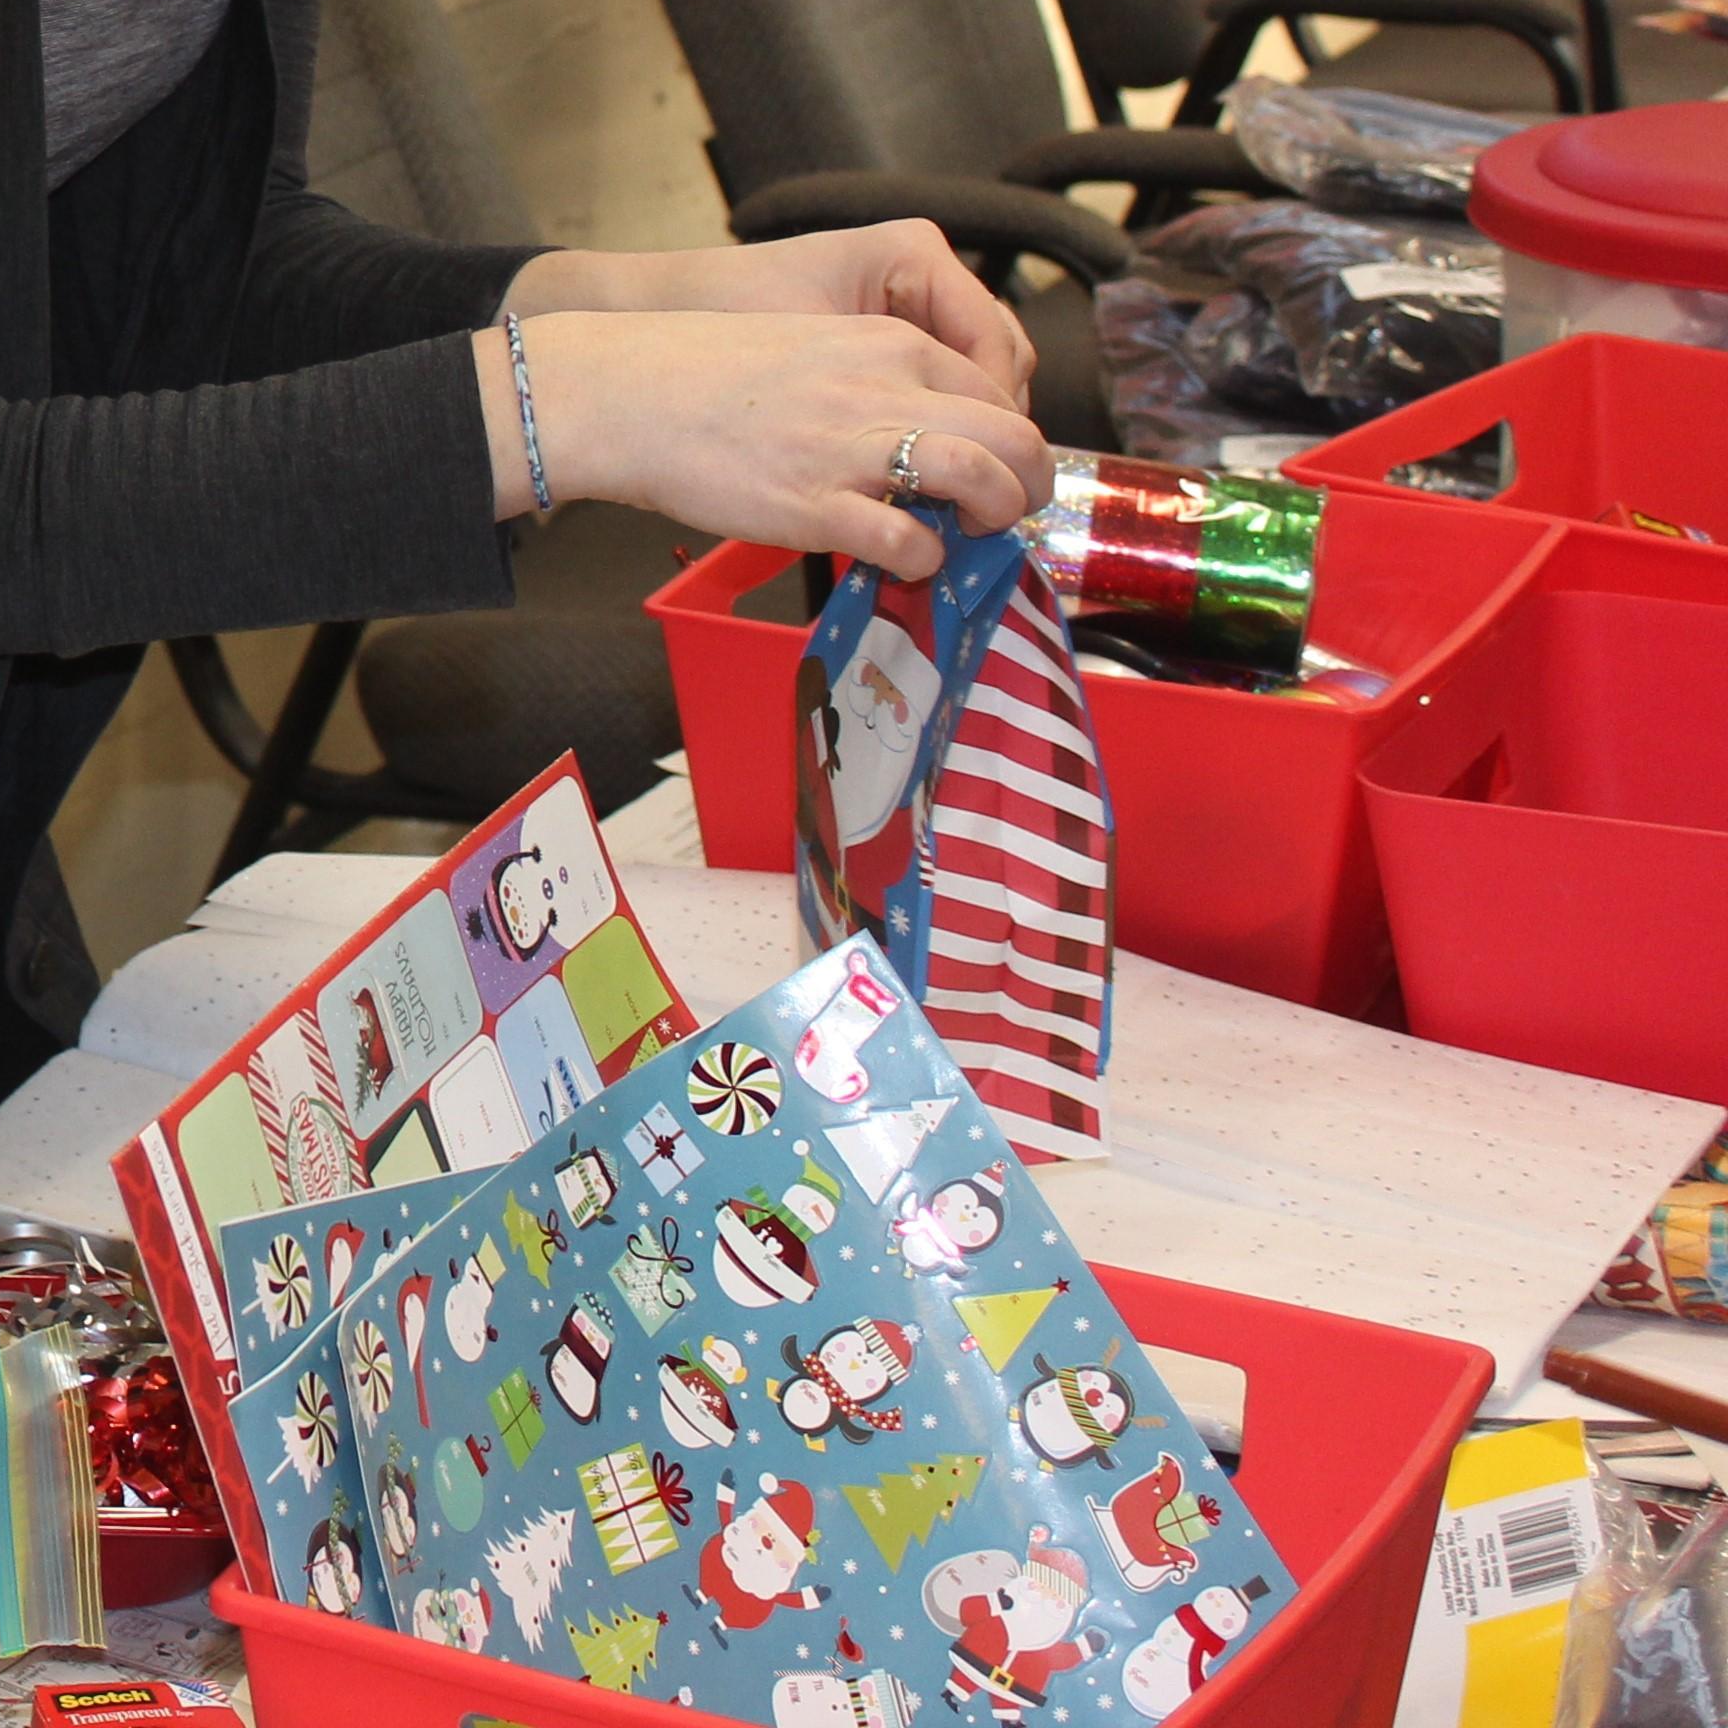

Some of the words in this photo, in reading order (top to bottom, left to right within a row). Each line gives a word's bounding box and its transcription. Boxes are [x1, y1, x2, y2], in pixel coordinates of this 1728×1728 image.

[385, 982, 415, 1051] HAPPY
[394, 941, 437, 1058] HOLIDAYS
[293, 1098, 334, 1198] RISTMAS
[58, 1689, 151, 1709] Scotch
[64, 1706, 174, 1727] Transparent
